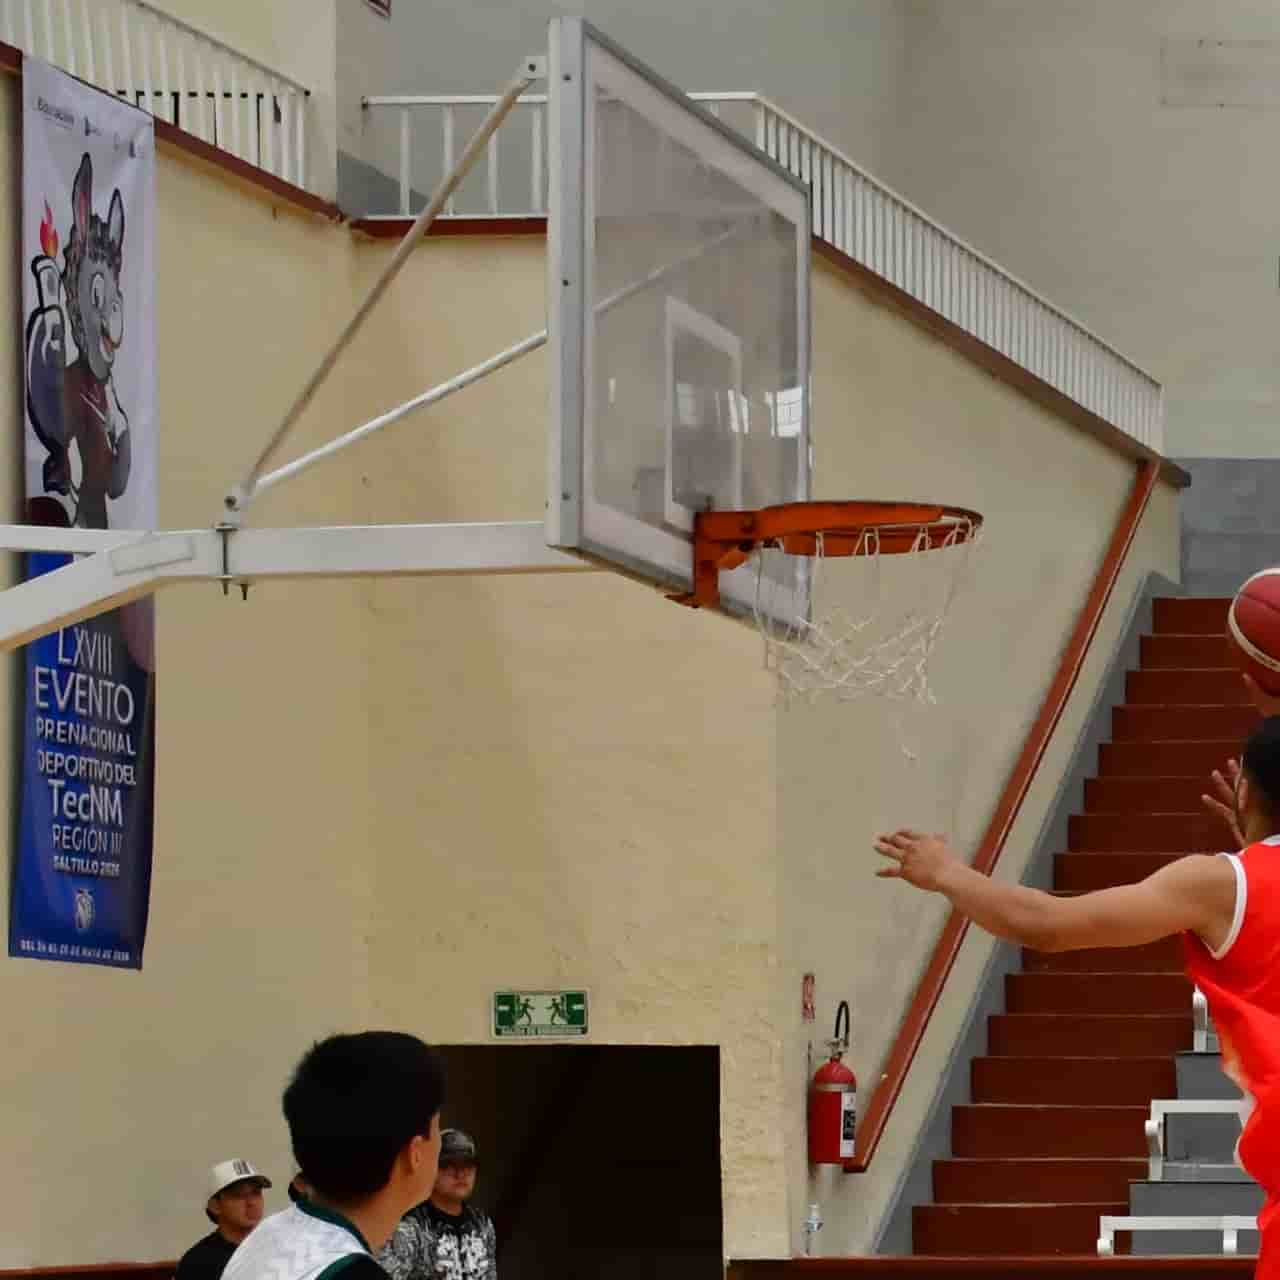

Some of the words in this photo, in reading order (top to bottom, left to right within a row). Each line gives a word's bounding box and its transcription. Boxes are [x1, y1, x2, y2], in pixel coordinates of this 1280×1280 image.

[57, 626, 112, 676] LXVIII
[35, 665, 134, 725] EVENTO
[36, 716, 137, 755] PRENACIONAL
[38, 750, 114, 784] DEPORTIVO
[115, 764, 137, 786] DEL
[48, 779, 123, 826] TecNM
[111, 831, 123, 857] III
